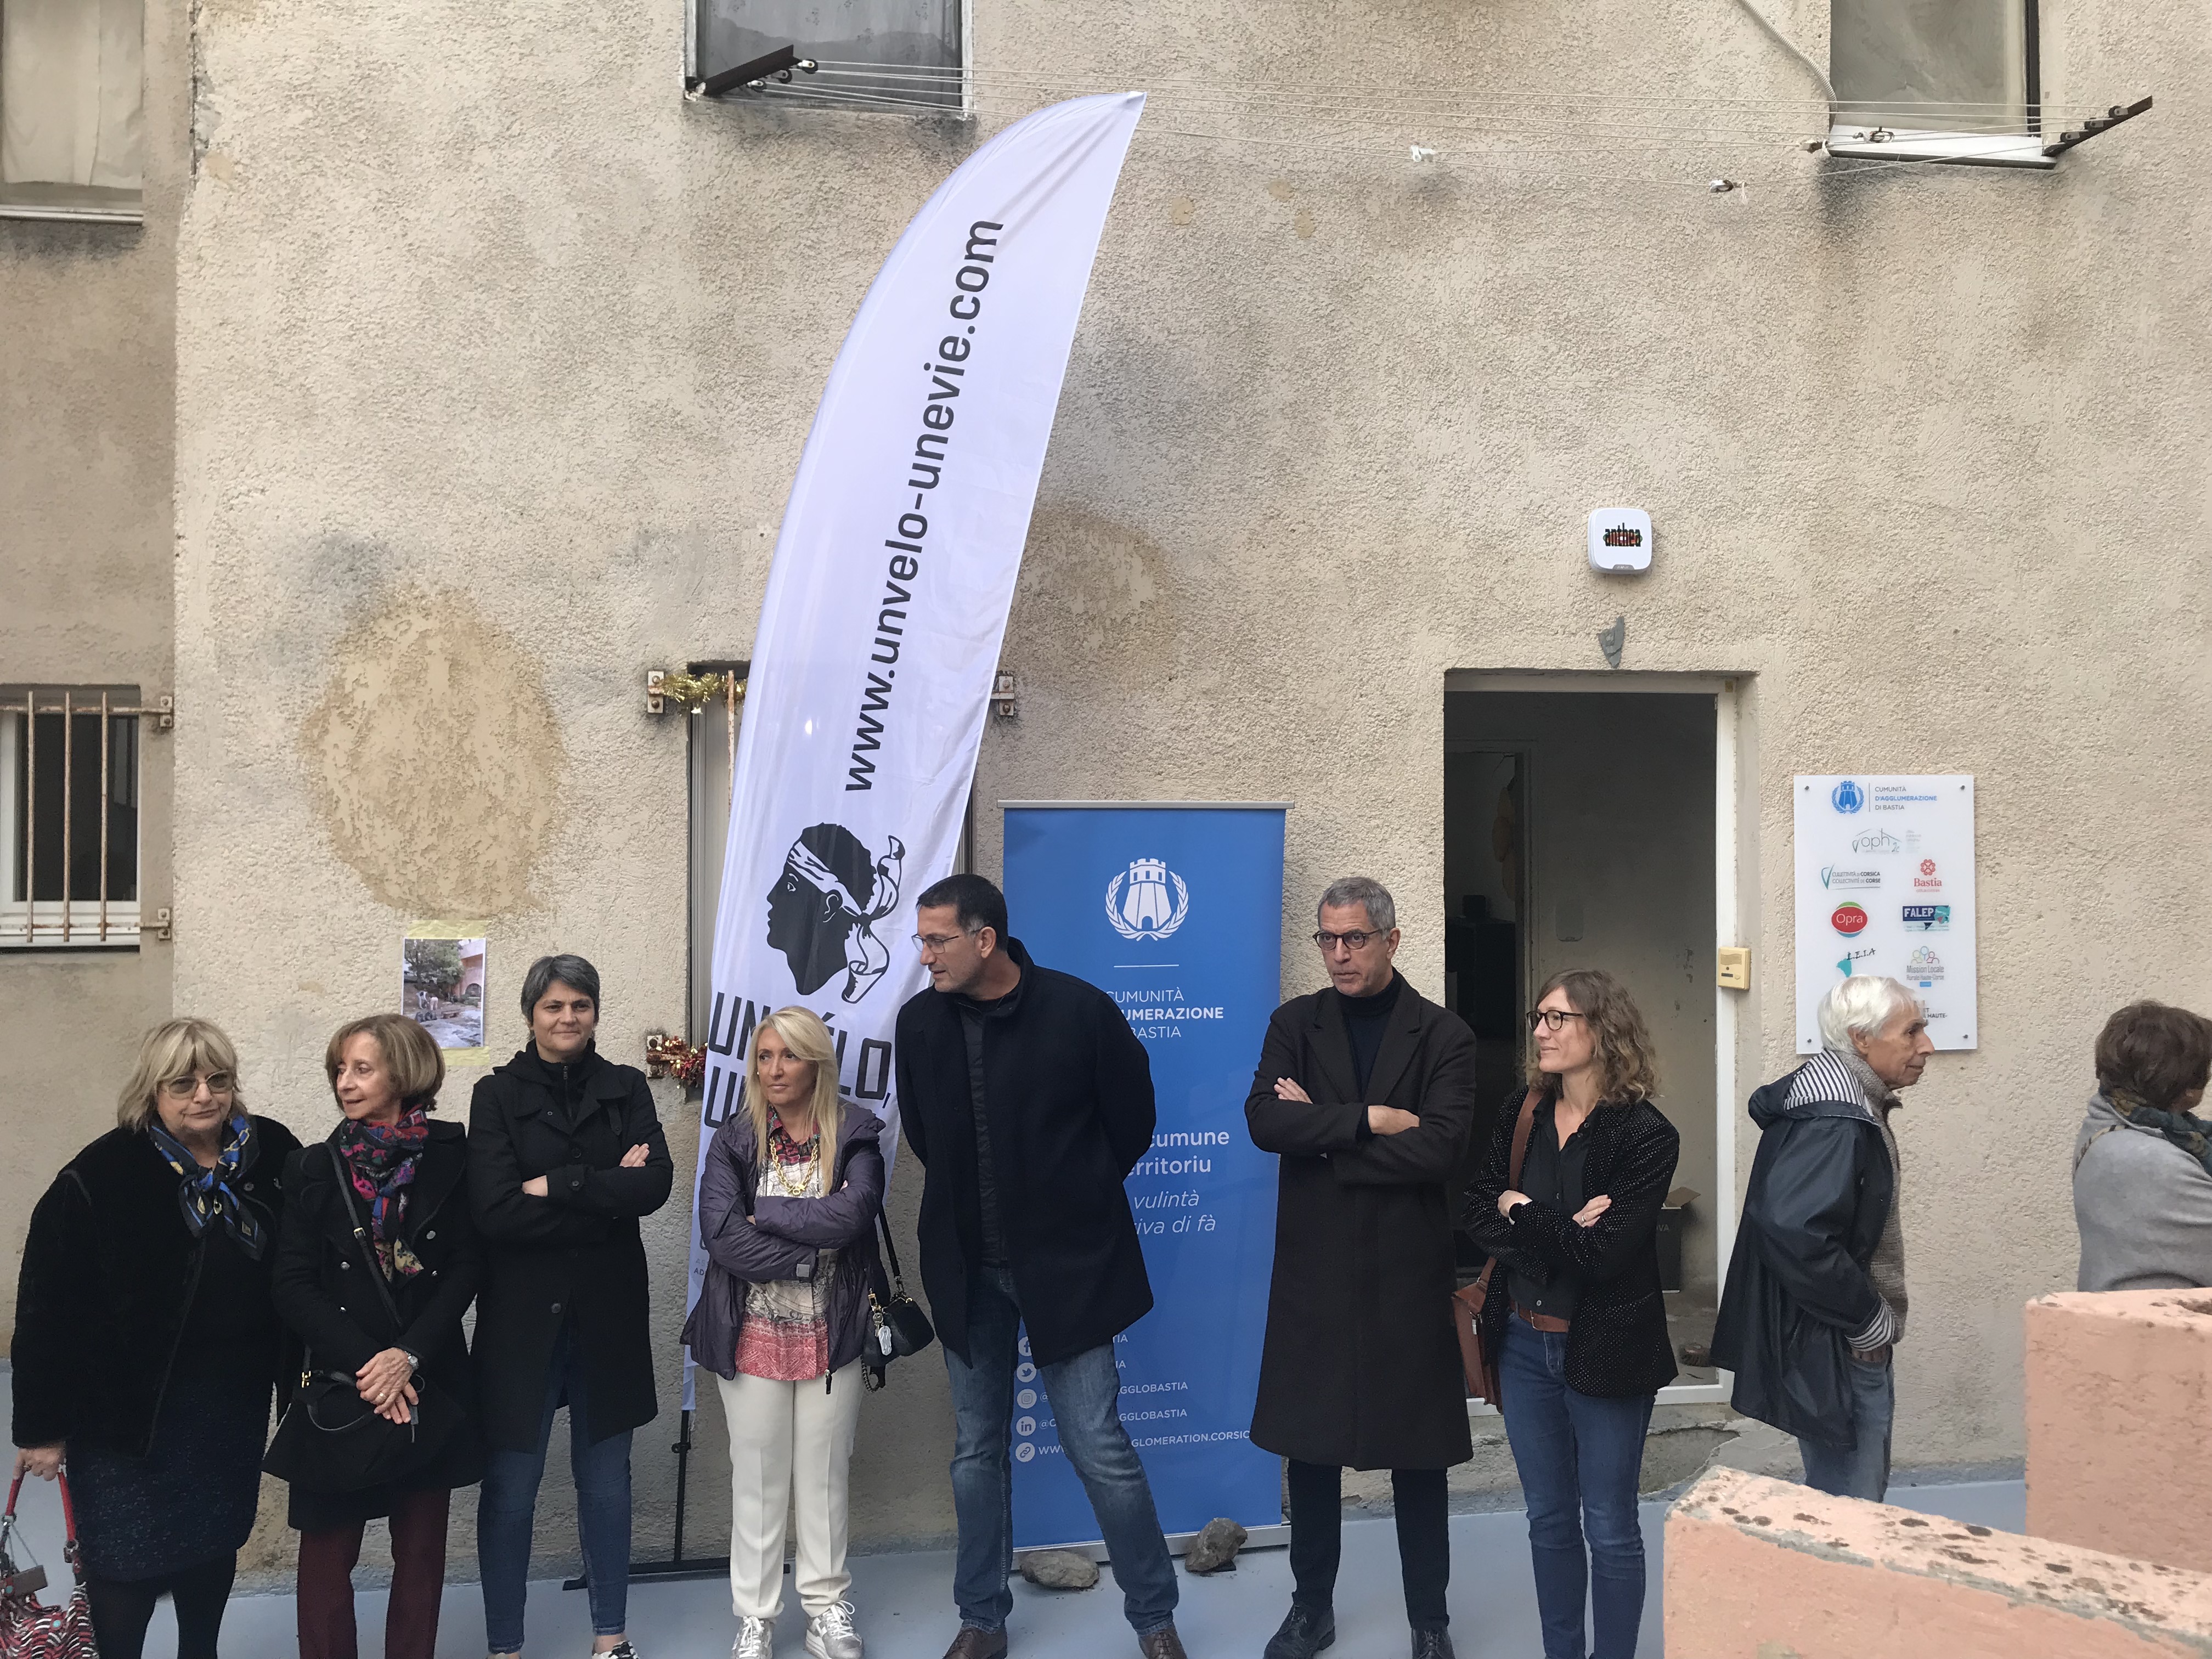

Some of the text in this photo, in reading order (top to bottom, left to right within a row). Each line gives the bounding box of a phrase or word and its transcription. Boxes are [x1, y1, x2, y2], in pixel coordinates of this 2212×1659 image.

[845, 221, 1003, 792] www.unvelo-unevie.com
[1914, 878, 1942, 887] Bastia
[1836, 913, 1863, 926] Opra
[1904, 908, 1934, 917] FALEP
[1121, 1007, 1224, 1021] UMERAZIONE
[1128, 1155, 1211, 1176] rritoriu
[1134, 1189, 1200, 1209] vulintà
[1172, 1215, 1192, 1233] di
[1197, 1214, 1216, 1232] fà
[1118, 1381, 1188, 1394] GGLOBASTIA
[1119, 1408, 1188, 1421] GGLOBASTIA
[1131, 1430, 1250, 1448] GLOMERATION.CORSIC
